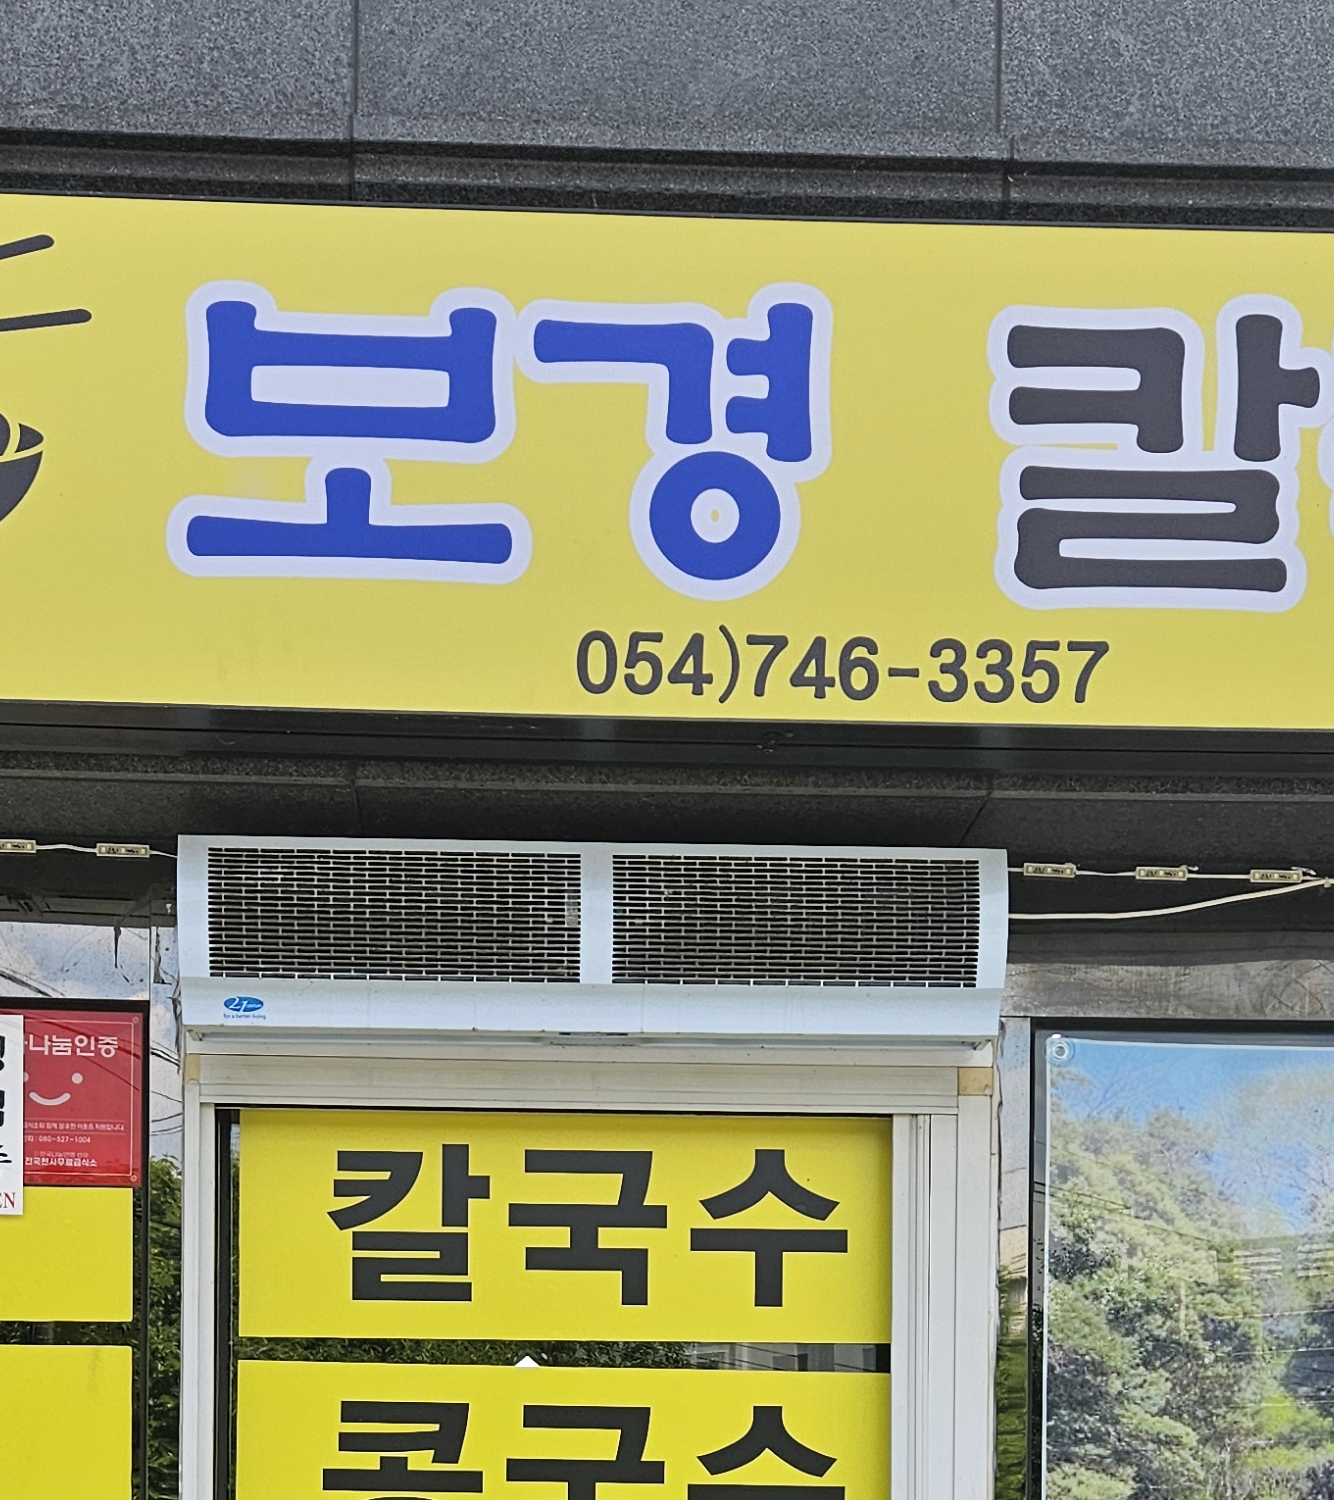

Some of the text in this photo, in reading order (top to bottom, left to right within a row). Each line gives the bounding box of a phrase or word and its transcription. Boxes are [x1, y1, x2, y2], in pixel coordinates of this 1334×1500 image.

[183, 297, 815, 584] 보경
[575, 623, 1111, 704] 054)746-3357
[25, 1034, 118, 1058] 나눔인증
[326, 1143, 848, 1308] 칼국수
